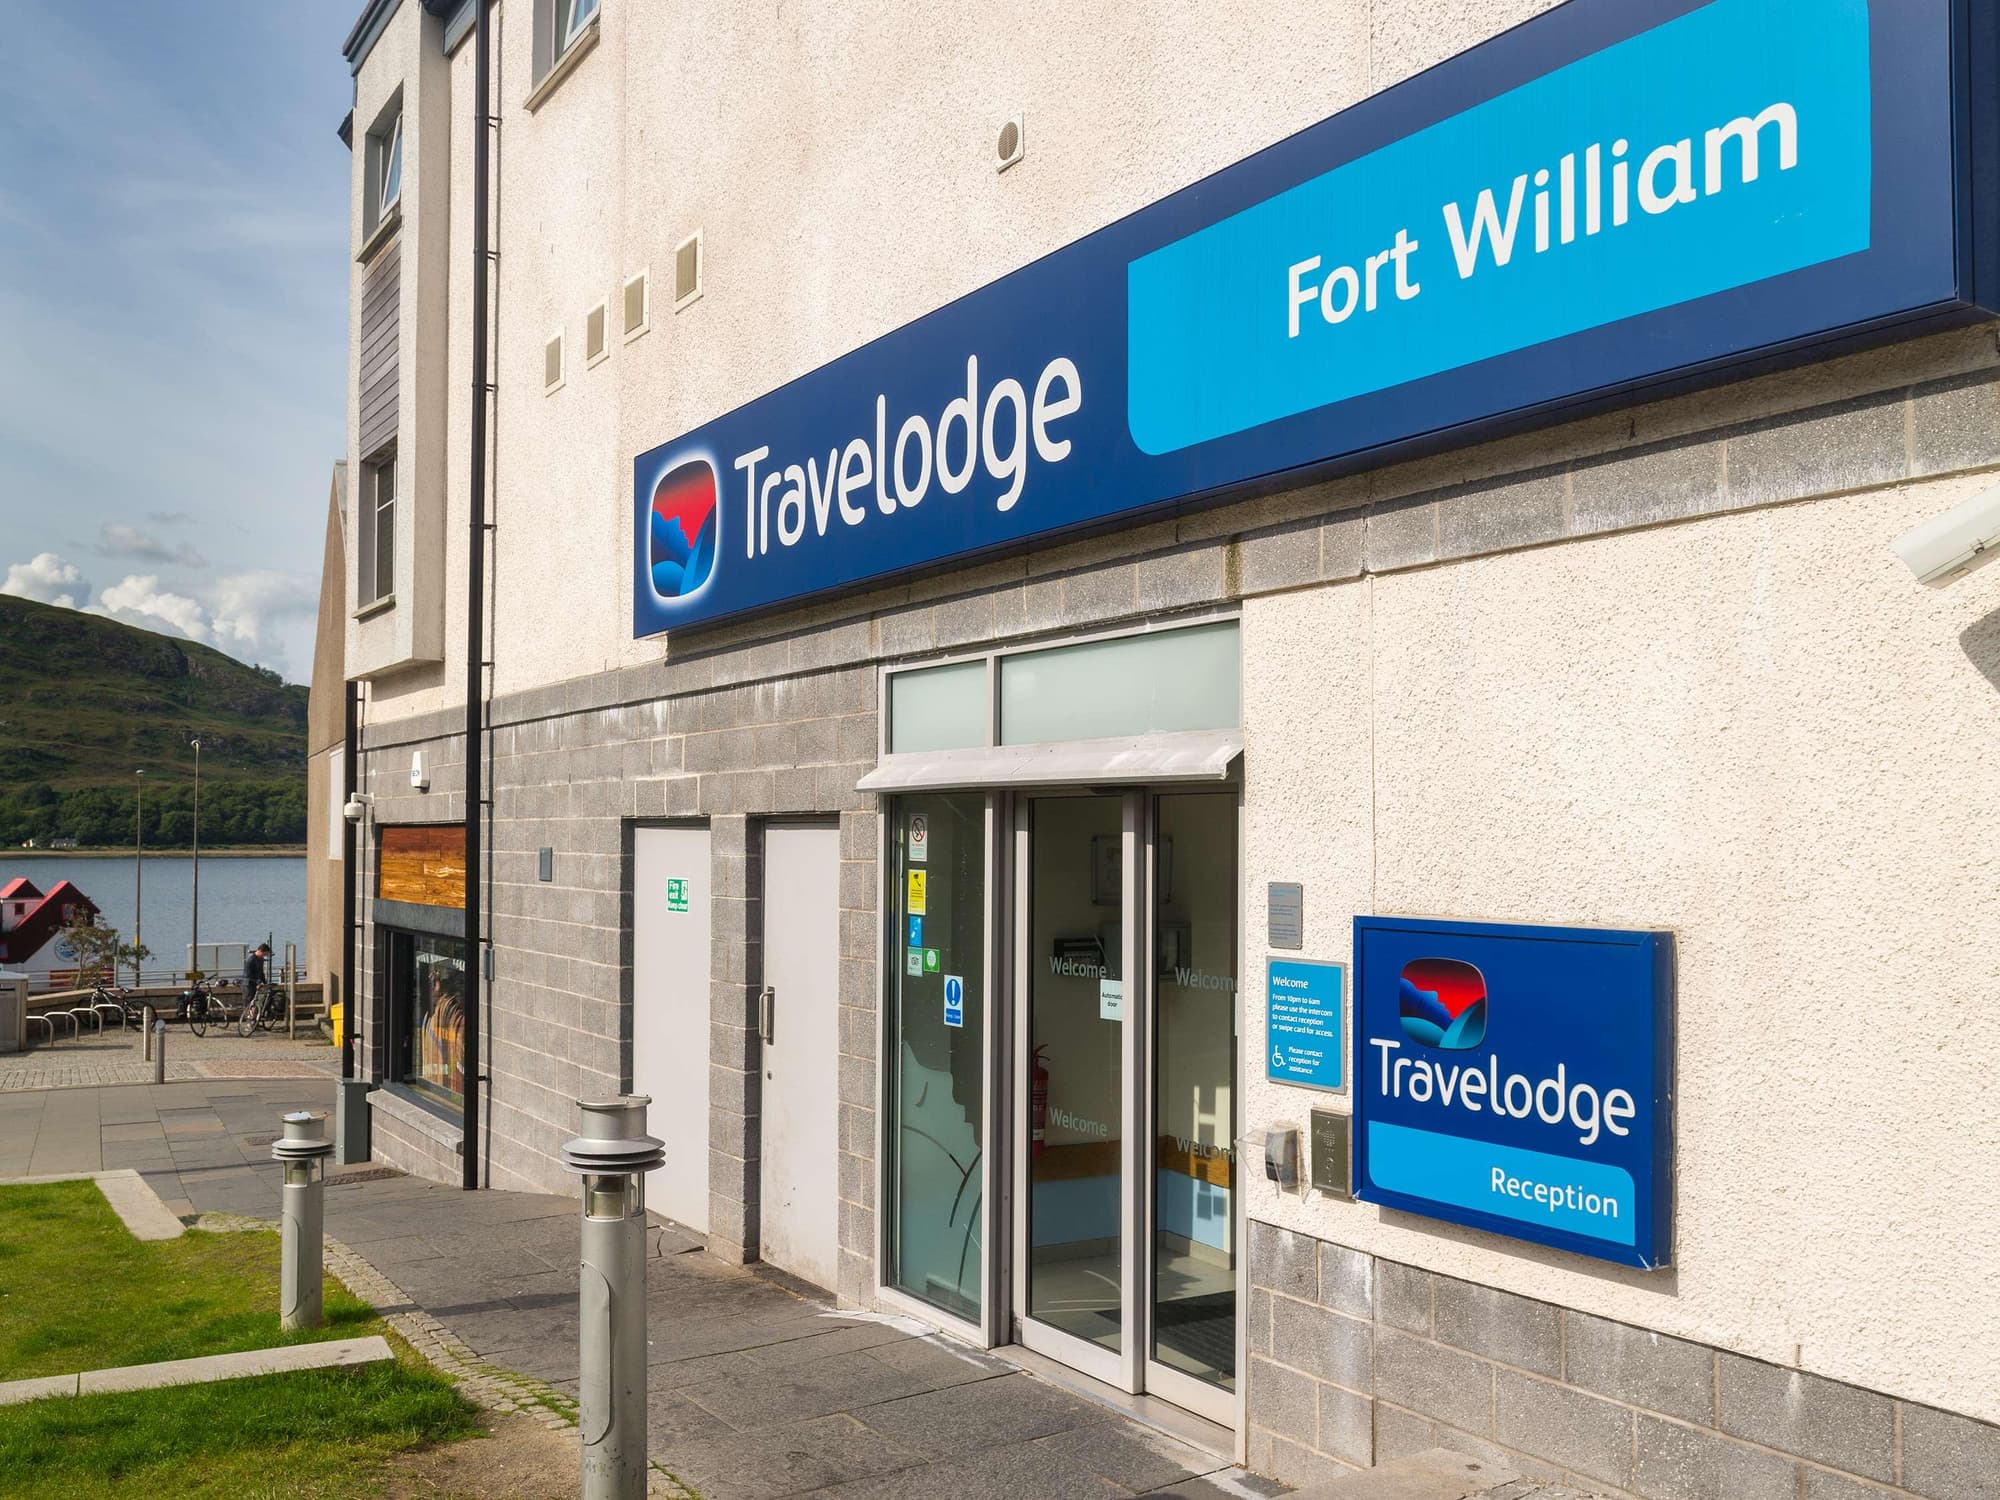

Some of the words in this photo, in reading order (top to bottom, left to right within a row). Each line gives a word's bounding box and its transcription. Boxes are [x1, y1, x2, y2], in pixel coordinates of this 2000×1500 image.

[1288, 228, 1421, 338] Fort
[1442, 102, 1798, 280] William
[734, 354, 1082, 559] Travelodge
[1049, 956, 1107, 979] Welcome
[1272, 975, 1309, 989] Welcome
[1272, 993, 1286, 1001] From
[1107, 1000, 1118, 1008] door
[1272, 1003, 1288, 1011] please
[1299, 1006, 1307, 1014] the
[1308, 1008, 1333, 1016] intercom
[1279, 1014, 1298, 1023] contact
[1298, 1017, 1324, 1026] reception
[1279, 1024, 1293, 1032] swipe
[1294, 1026, 1306, 1034] card
[1306, 1027, 1314, 1035] for
[1288, 1046, 1304, 1054] Please
[1304, 1049, 1323, 1058] contact
[1288, 1056, 1312, 1065] reception
[1370, 1038, 1636, 1146] Travelodge
[1049, 1106, 1108, 1137] Welcome
[1491, 1167, 1619, 1218] Reception
